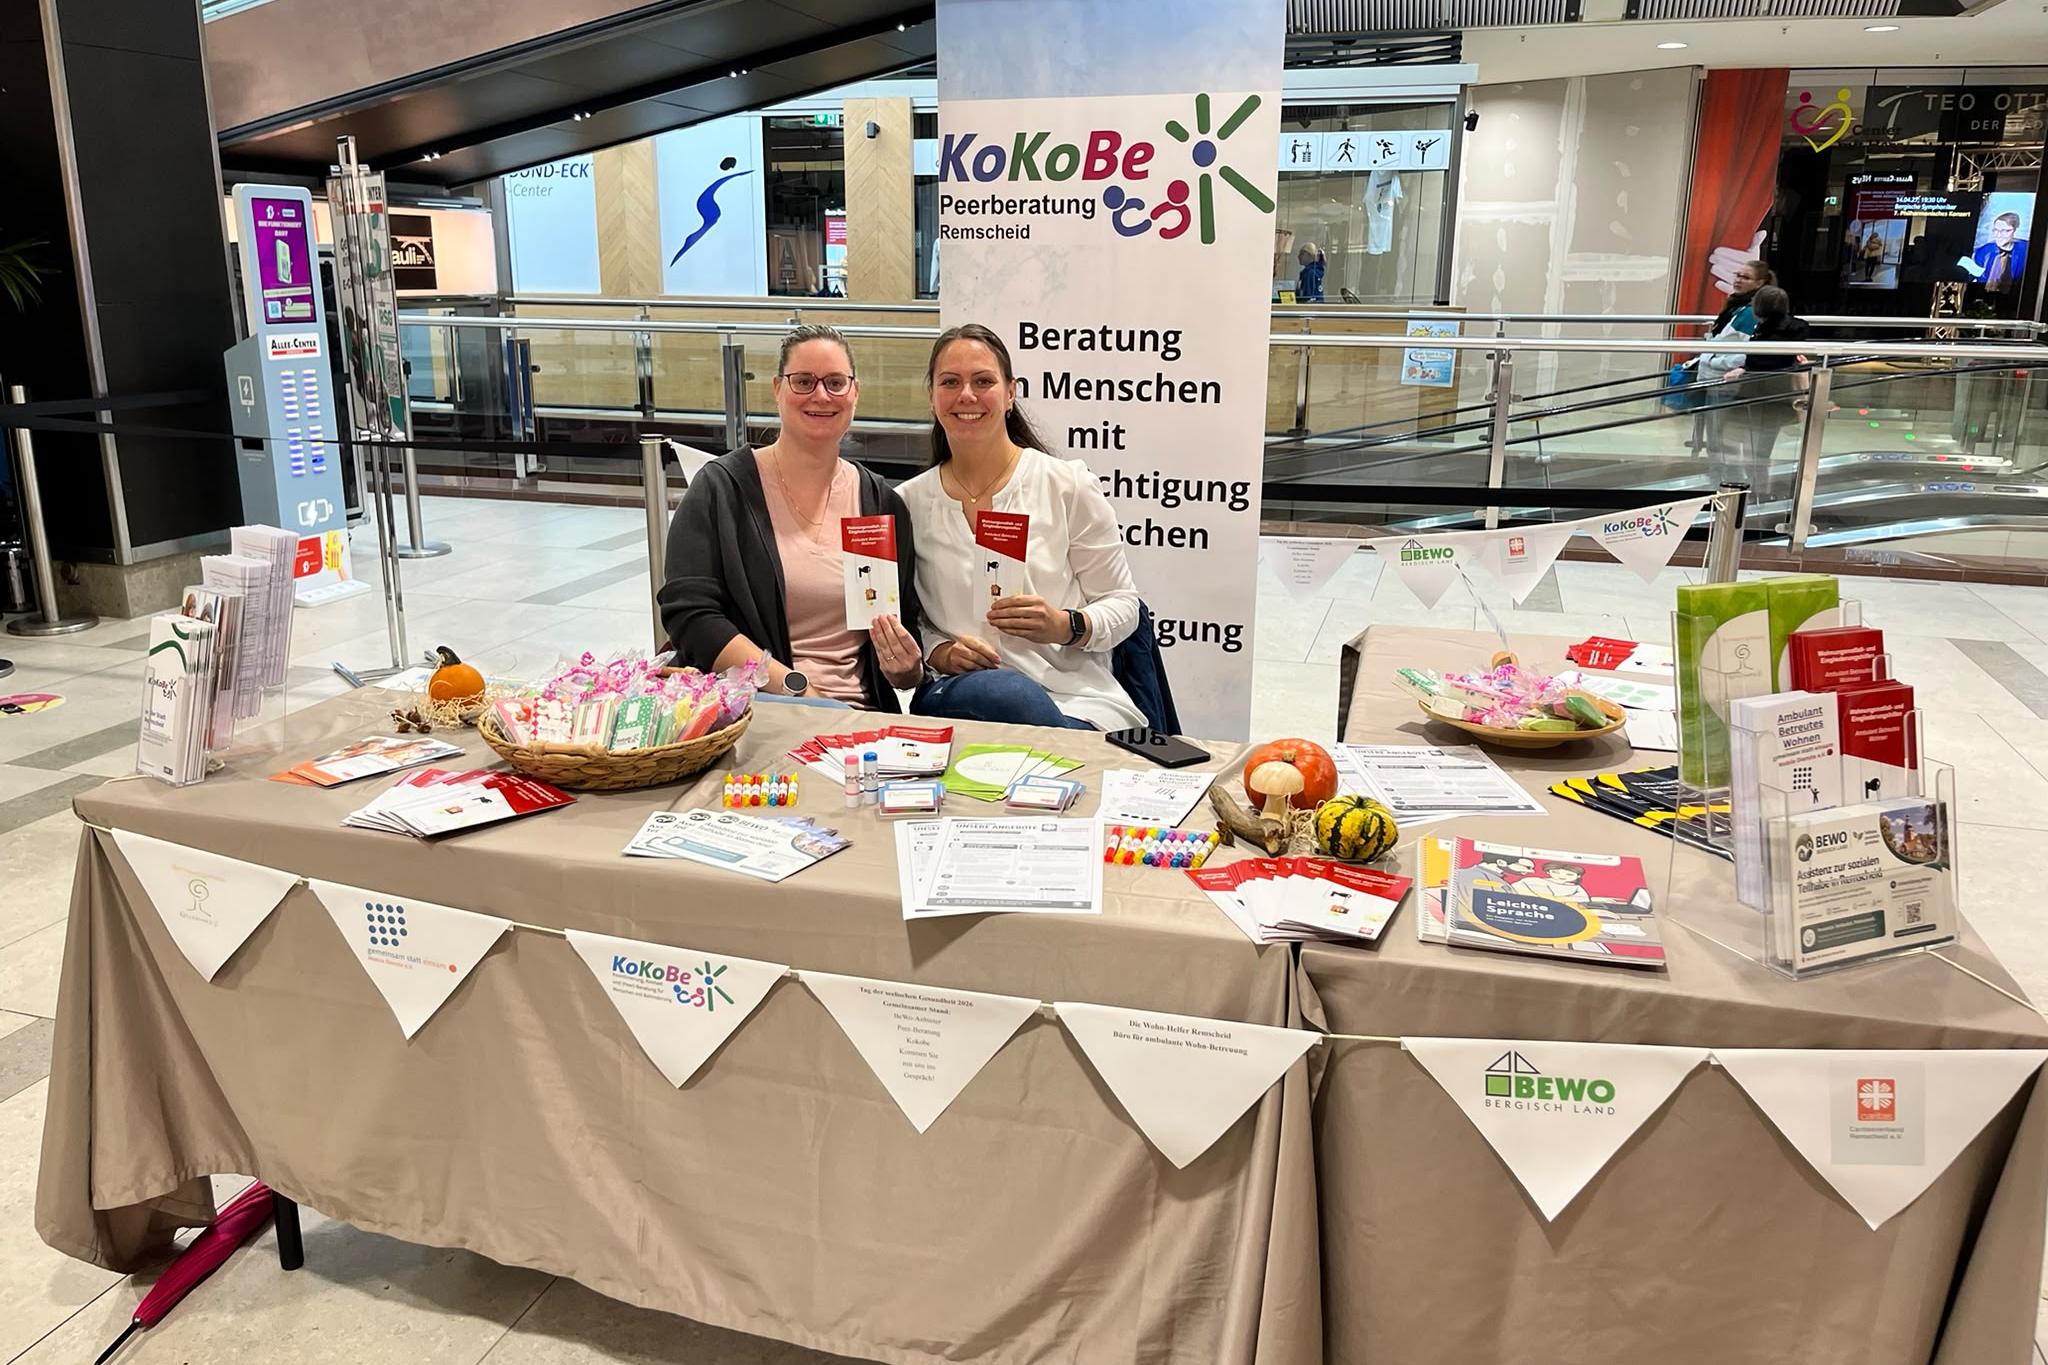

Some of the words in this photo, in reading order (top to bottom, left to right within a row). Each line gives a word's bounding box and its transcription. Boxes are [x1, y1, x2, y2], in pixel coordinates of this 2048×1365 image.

[1923, 94, 1975, 111] TEO
[1994, 94, 2047, 111] OTT
[1970, 120, 1999, 130] DER
[939, 130, 1155, 183] KoKoBe
[940, 195, 1096, 219] Peerberatung
[940, 224, 1031, 240] Remscheid
[1019, 322, 1182, 361] Beratung
[1015, 376, 1029, 398] n
[1043, 372, 1221, 403] Menschen
[1068, 421, 1126, 450] mit
[1099, 469, 1250, 512] chtigung
[1604, 518, 1652, 533] KoKoBe
[1413, 547, 1454, 560] BEWO
[1149, 612, 1244, 653] igung
[1777, 707, 1823, 722] Ambulant
[1779, 720, 1824, 736] Betreutes
[1783, 733, 1821, 748] Wohnen
[1816, 831, 1848, 848] BEWO
[1797, 867, 1832, 880] Assistenz
[1834, 863, 1846, 873] zur
[1847, 856, 1880, 870] sozialen
[1486, 897, 1549, 911] Leichte
[1486, 905, 1555, 920] Sprache
[368, 948, 405, 960] gemeinsam
[406, 954, 421, 964] statt
[612, 956, 691, 985] KoKoBe
[860, 986, 871, 994] Tag
[885, 990, 917, 999] seelischen
[919, 995, 956, 1005] Gesundheit
[883, 1001, 927, 1012] Gemeinsamer
[1129, 1020, 1141, 1028] Die
[1143, 1022, 1189, 1034] Wohn-Helfer
[1192, 1028, 1231, 1039] Remscheid
[1113, 1031, 1131, 1039] Büro
[1145, 1036, 1183, 1047] ambulante
[1185, 1041, 1248, 1055] Wohn-Betreuung
[899, 1048, 927, 1057] Kommen
[904, 1072, 935, 1081] Gespräch!
[1515, 1075, 1615, 1103] BEWO
[1485, 1099, 1563, 1112] BERGISCH
[1574, 1105, 1616, 1115] LAND
